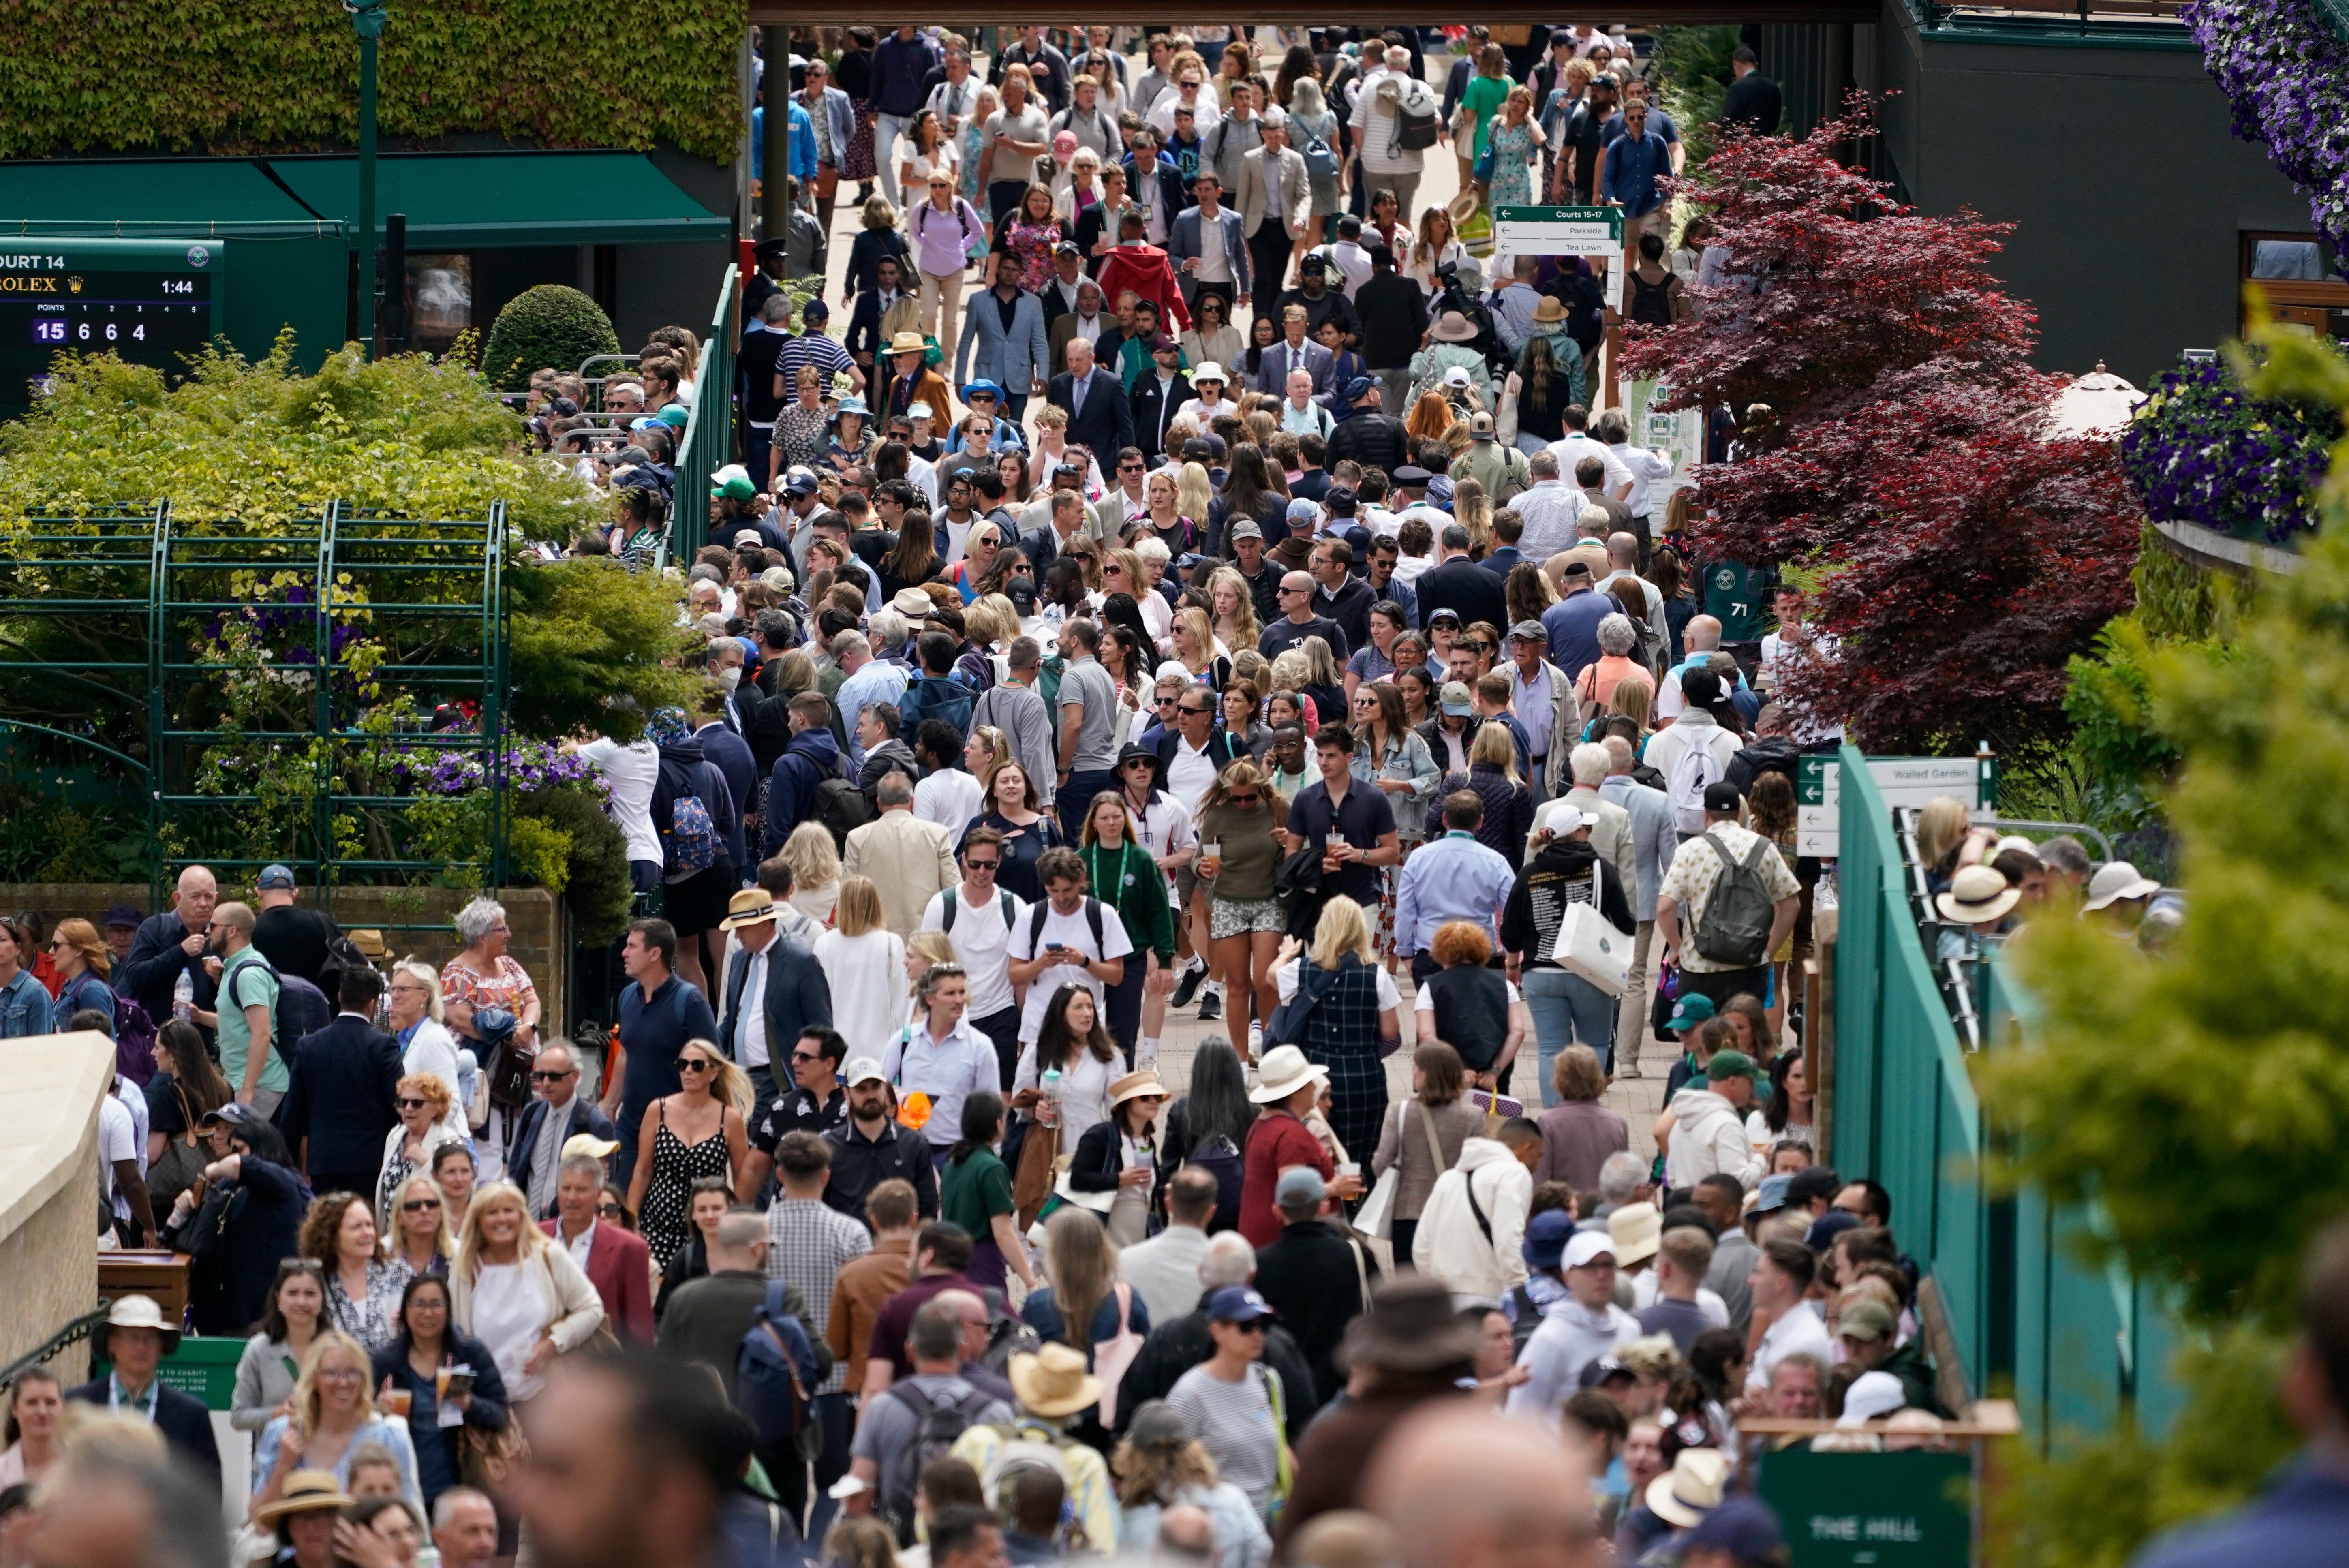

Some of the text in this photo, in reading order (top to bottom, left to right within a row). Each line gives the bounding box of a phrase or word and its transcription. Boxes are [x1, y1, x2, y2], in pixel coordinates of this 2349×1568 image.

[46, 255, 65, 269] 14
[0, 277, 57, 291] OLEX
[162, 280, 193, 293] 1:44
[38, 323, 145, 341] 15 6 6 4
[1731, 603, 1748, 617] 71
[1894, 769, 1968, 779] Walled Garden
[1864, 1516, 1921, 1542] HILL
